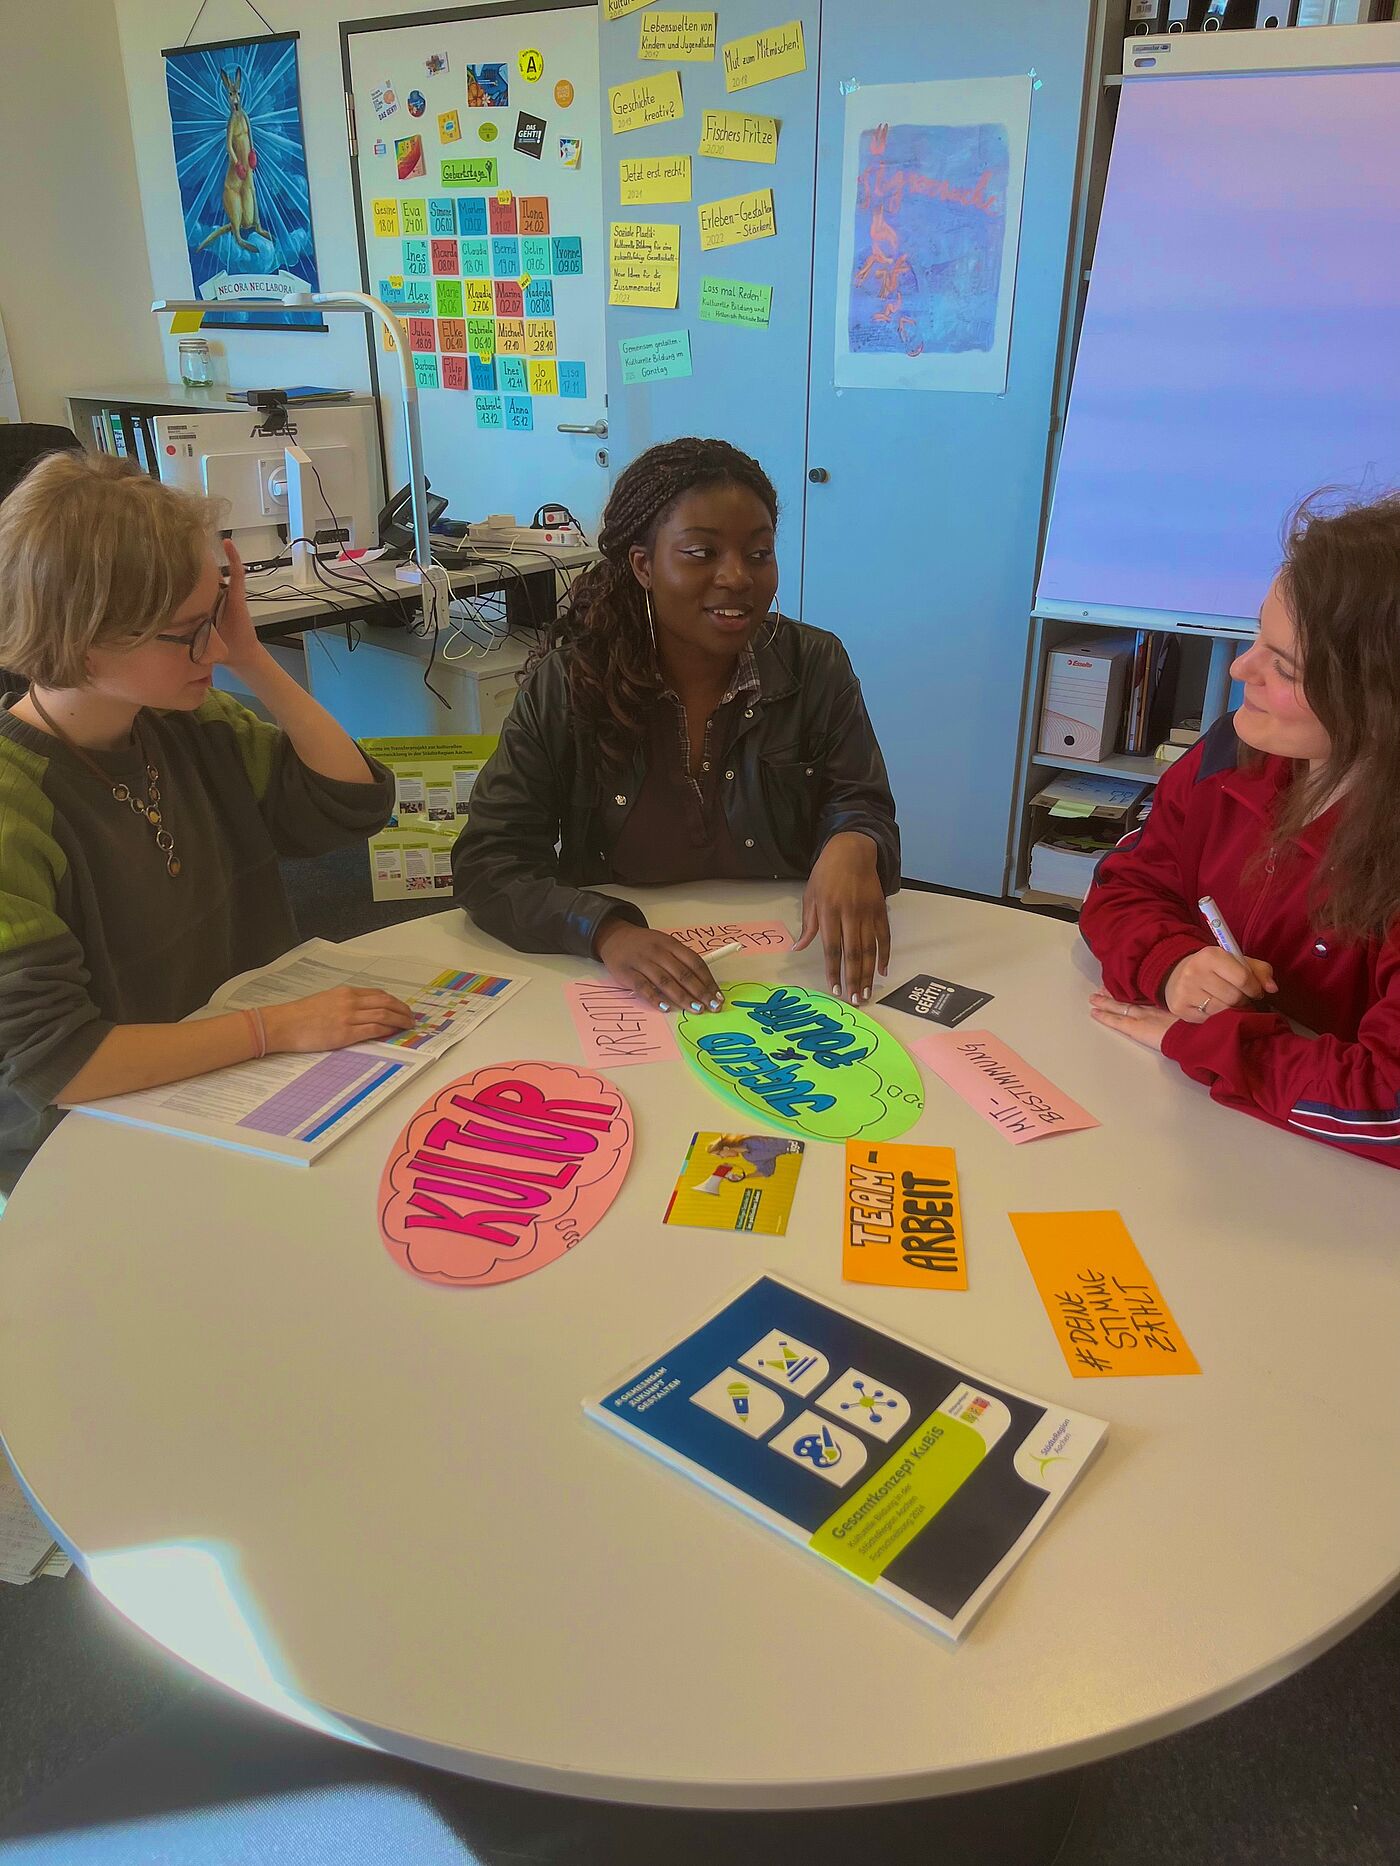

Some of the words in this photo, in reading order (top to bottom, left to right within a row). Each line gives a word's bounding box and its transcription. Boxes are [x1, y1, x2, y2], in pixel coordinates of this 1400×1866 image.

[643, 14, 698, 33] Lebenswelten
[700, 22, 713, 32] von
[641, 35, 666, 50] Kindern
[667, 35, 679, 50] und
[725, 49, 740, 73] Mut
[742, 54, 756, 66] zum
[756, 28, 800, 60] Mitmischen!
[612, 86, 656, 115] Geschichte
[643, 100, 676, 123] kreativ?
[705, 115, 741, 143] Fischers
[742, 118, 773, 145] Fritze
[621, 163, 645, 183] Jetzt
[646, 162, 662, 179] erst
[663, 160, 686, 179] recht!
[374, 201, 396, 215] Gesine
[403, 202, 421, 217] Eva
[521, 200, 544, 219] Ilona
[613, 225, 634, 238] Soziale
[406, 242, 426, 262] Ines
[493, 240, 517, 254] Bernd
[553, 239, 581, 259] Yvonne
[217, 284, 234, 296] NEC
[233, 282, 249, 293] ORA
[249, 282, 265, 292] NEC
[265, 282, 293, 294] LABORA
[407, 282, 429, 300] Alex
[467, 282, 492, 299] Klaudia
[613, 279, 662, 293] Zusammenarbeit
[703, 280, 719, 295] Lass
[720, 285, 736, 298] mal
[730, 301, 753, 314] Bildung
[442, 320, 463, 338] Elke
[497, 322, 524, 338] Michael
[528, 322, 554, 338] Ulrike
[622, 342, 654, 354] Gemeinsam
[652, 353, 676, 363] Bildung
[535, 364, 546, 379] Jo
[560, 367, 580, 379] Lisa
[641, 366, 668, 378] Ganztag
[508, 399, 529, 415] Anna
[908, 986, 925, 1002] DAS
[575, 982, 661, 1056] KREATIV
[696, 1031, 838, 1118] JUGEND
[956, 1042, 1065, 1124] BESTIMMUNG
[404, 1079, 618, 1248] KULTUR
[900, 1169, 958, 1272] ARBEIT
[1076, 1268, 1138, 1349] STIMME
[628, 1378, 665, 1408] ZUKUNFT
[637, 1378, 681, 1413] GESTALTEN
[1040, 1417, 1071, 1457] StädteRegion
[1053, 1432, 1072, 1455] Aachen
[831, 1457, 916, 1540] Gesamtkonzept
[910, 1425, 945, 1460] KuBiS
